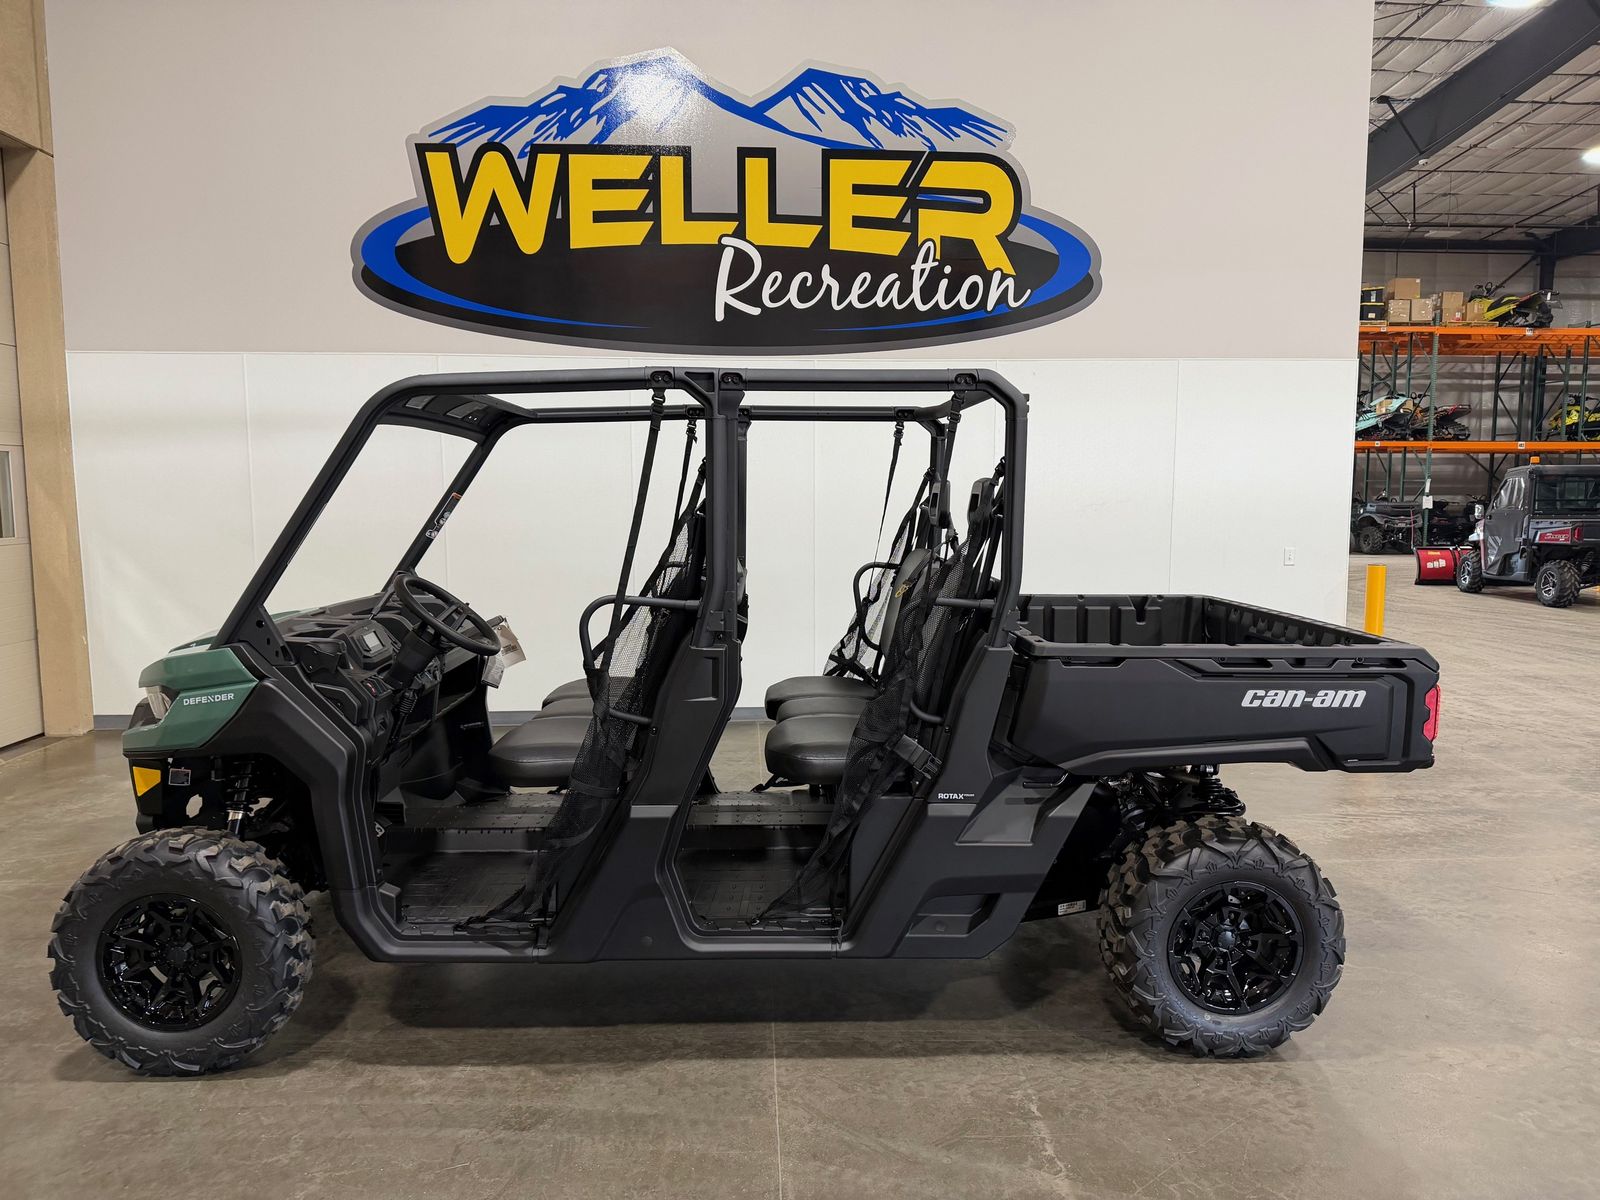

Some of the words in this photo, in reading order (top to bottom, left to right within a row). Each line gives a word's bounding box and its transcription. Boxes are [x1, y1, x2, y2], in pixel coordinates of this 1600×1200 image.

[425, 151, 1017, 276] WELLER
[715, 236, 1031, 322] Recreation
[183, 693, 235, 706] DEFENDER
[1241, 689, 1367, 708] can-am
